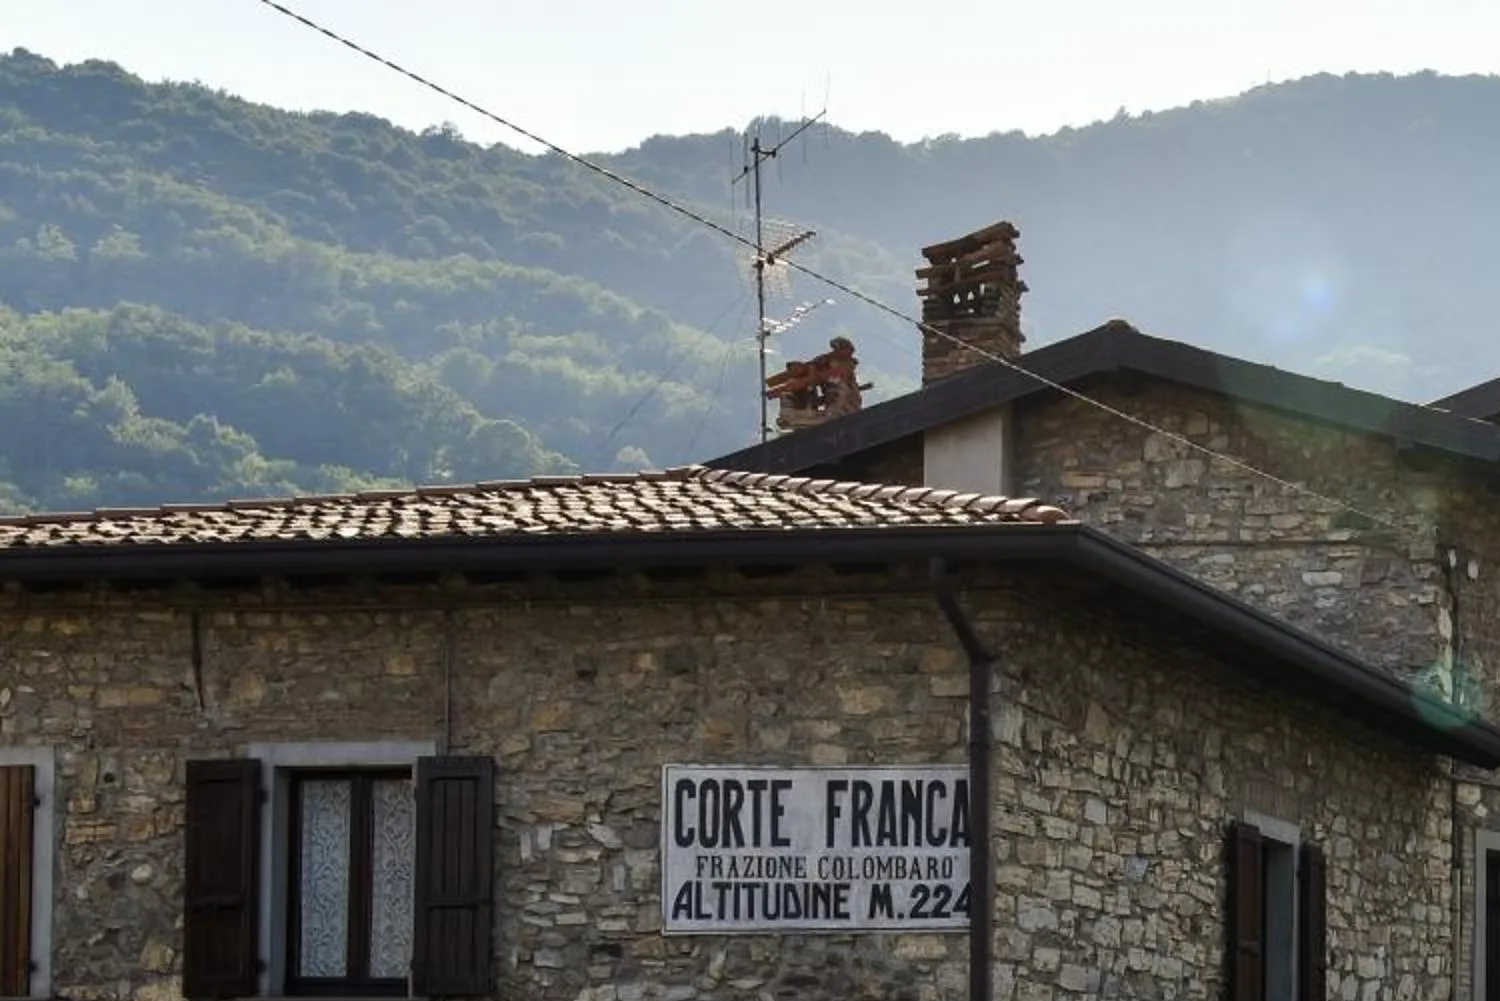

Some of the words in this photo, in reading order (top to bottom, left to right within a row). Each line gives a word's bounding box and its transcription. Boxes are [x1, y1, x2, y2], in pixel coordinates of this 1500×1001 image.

[674, 778, 793, 848] CORTE
[826, 779, 971, 847] FRANCA
[696, 855, 807, 879] FRAZIONE
[817, 855, 953, 880] COLOMBARO
[671, 880, 850, 920] ALTITUDINE
